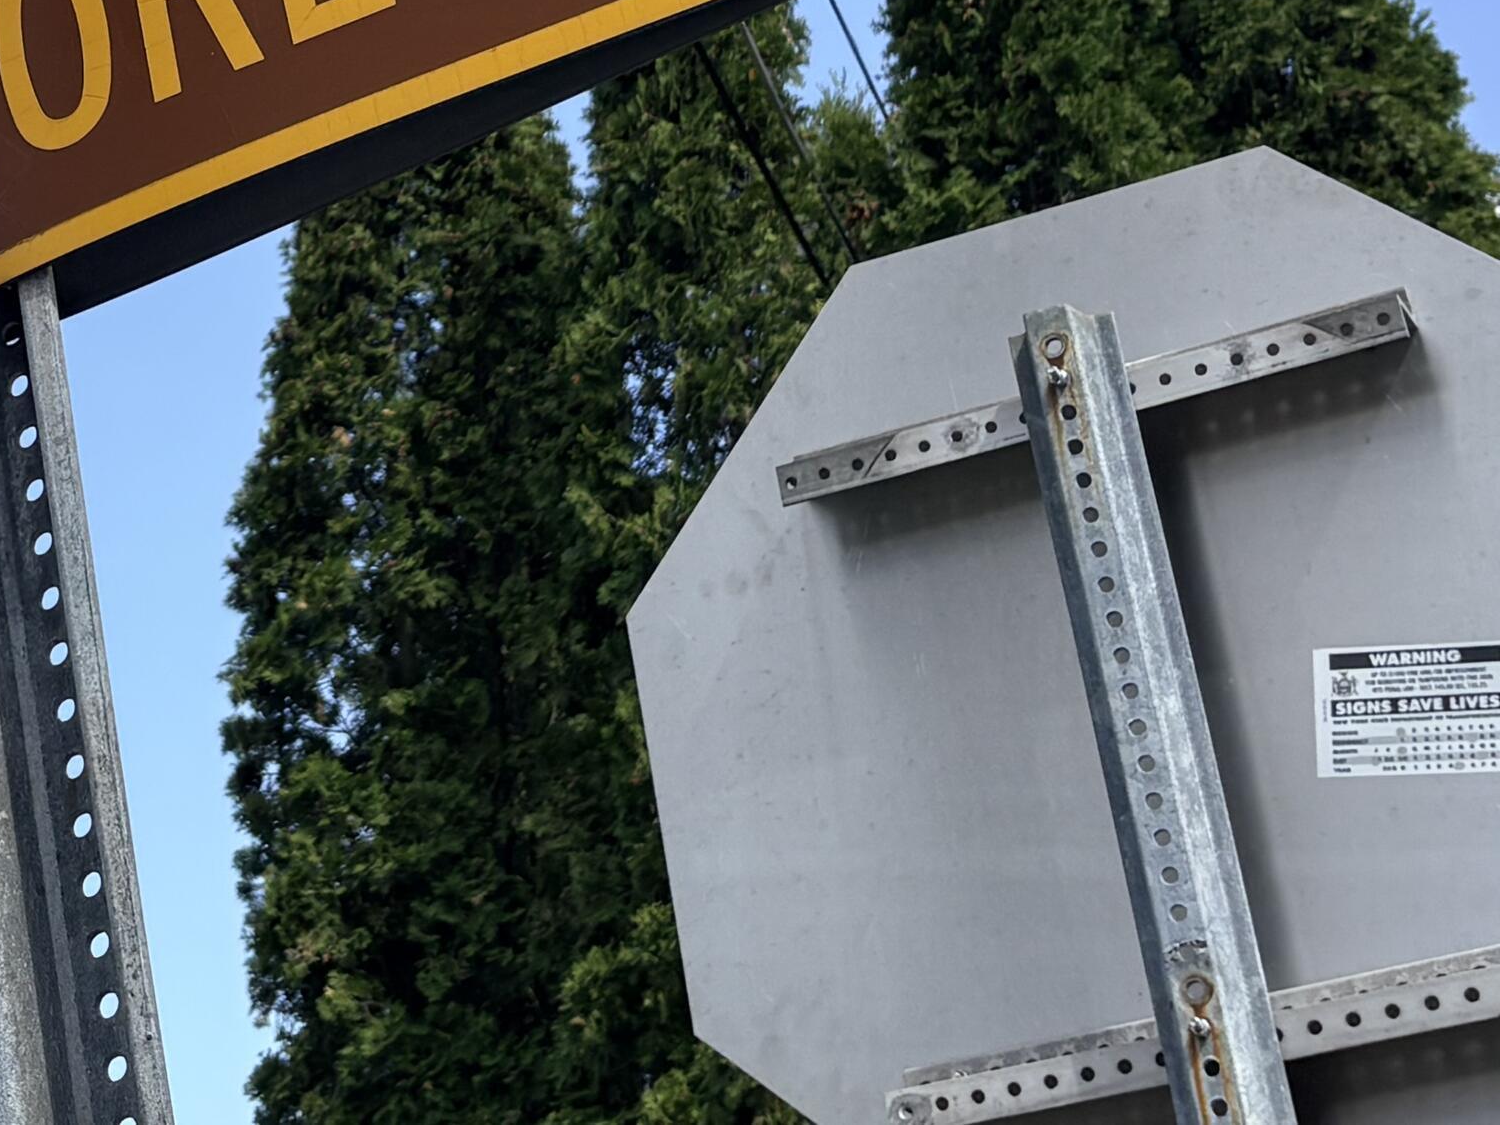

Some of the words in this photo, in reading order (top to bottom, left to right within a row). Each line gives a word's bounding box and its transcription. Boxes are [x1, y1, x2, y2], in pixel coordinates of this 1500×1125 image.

[1368, 649, 1462, 667] WARNING
[1335, 699, 1392, 716] SIGNS
[1397, 697, 1444, 713] SAVE
[1449, 694, 1500, 710] LIVES
